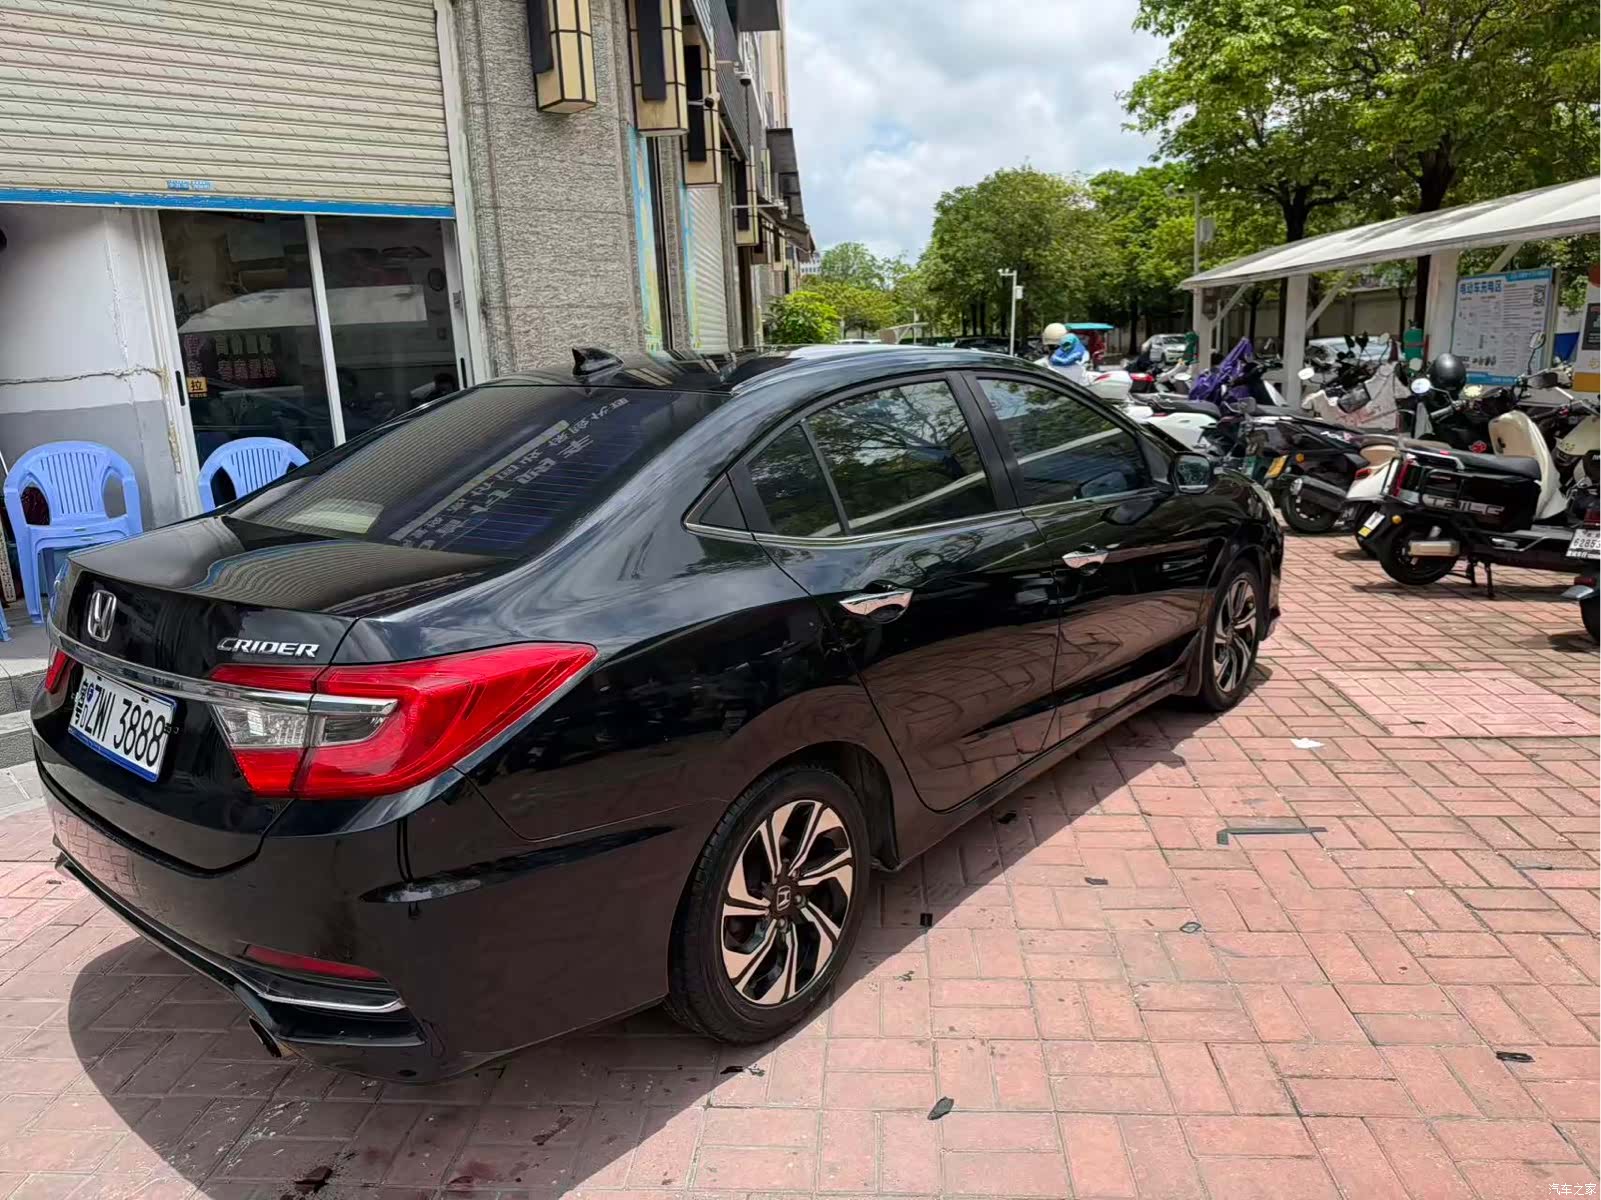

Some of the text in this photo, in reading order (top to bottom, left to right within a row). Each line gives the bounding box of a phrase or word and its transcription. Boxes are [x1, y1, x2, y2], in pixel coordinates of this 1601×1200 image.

[190, 379, 204, 391] 拉
[216, 637, 320, 658] CRIDER
[113, 698, 167, 768] 3888
